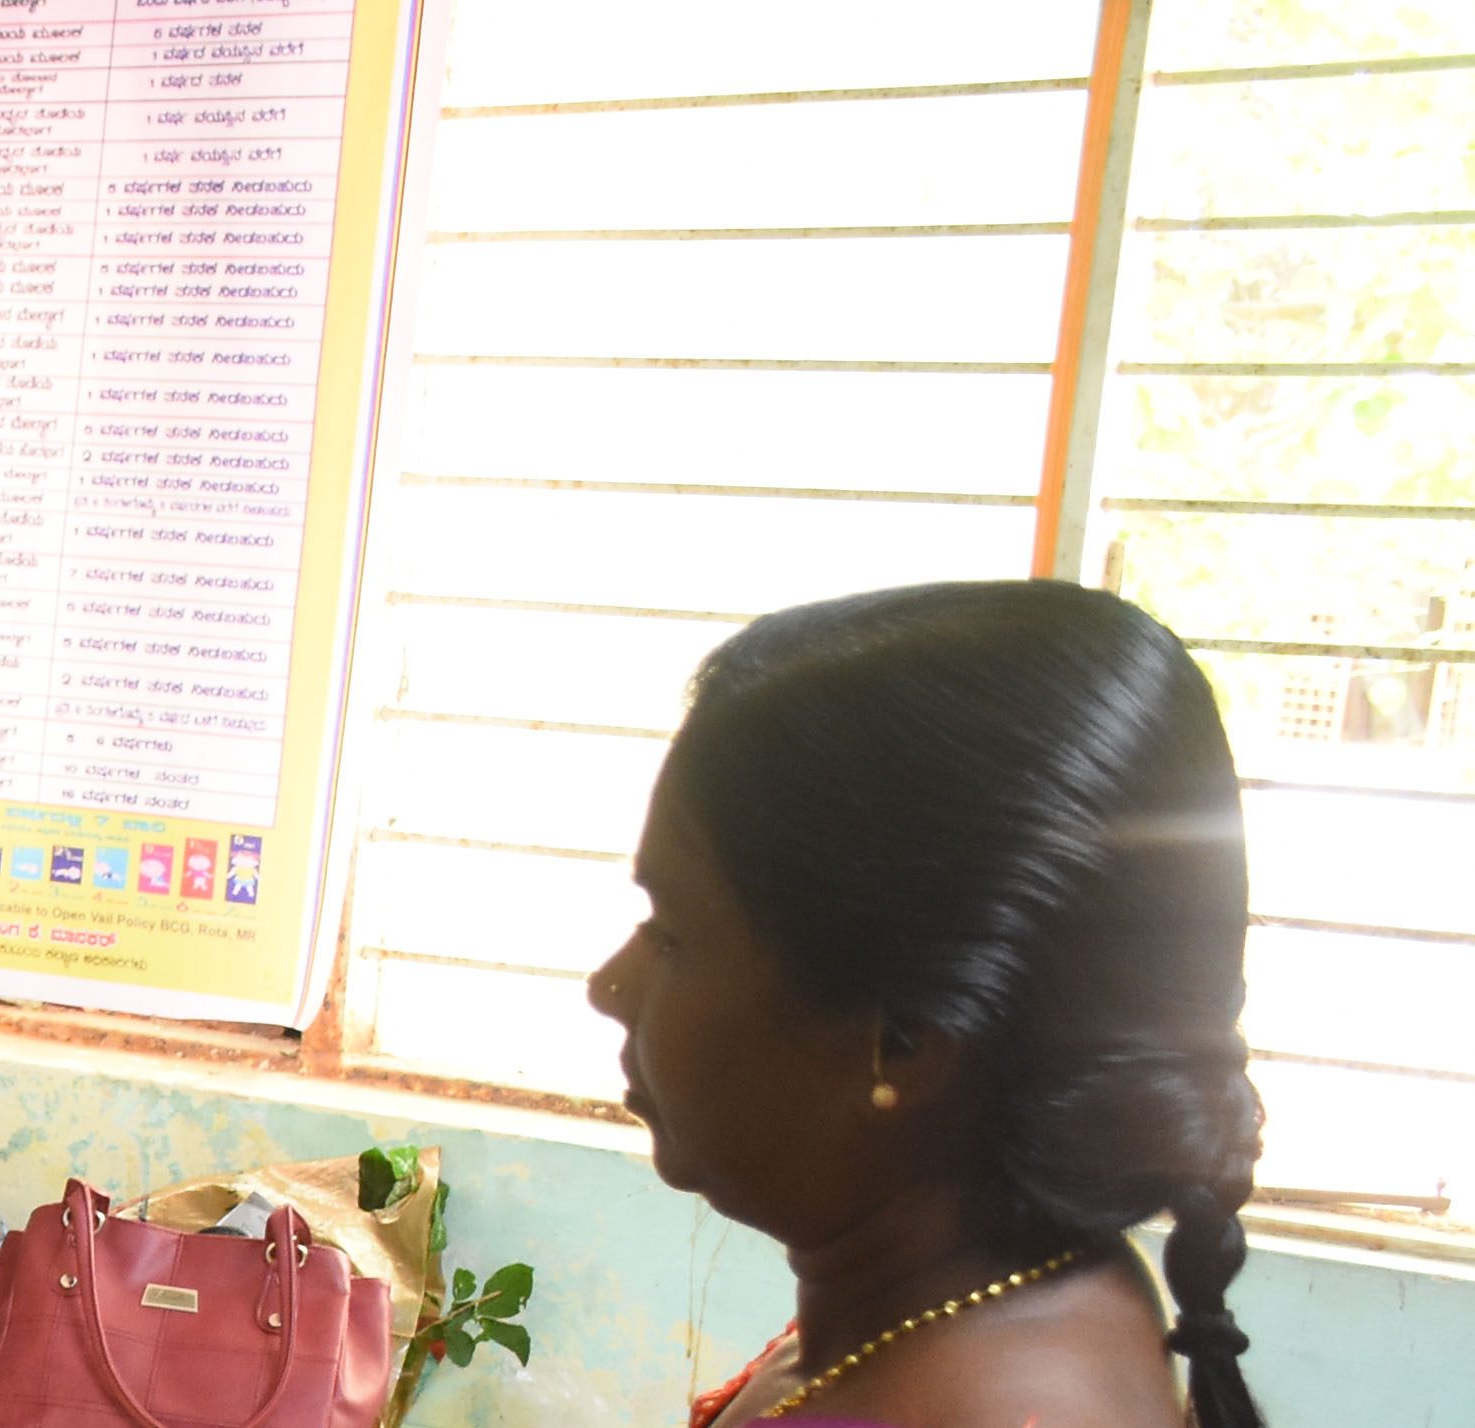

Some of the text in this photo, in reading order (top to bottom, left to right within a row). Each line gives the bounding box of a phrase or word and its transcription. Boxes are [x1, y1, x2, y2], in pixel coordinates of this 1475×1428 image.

[35, 904, 49, 917] to
[52, 906, 87, 924] Open
[90, 911, 113, 925] Vail
[117, 913, 156, 933] Policy
[236, 929, 256, 942] MR
